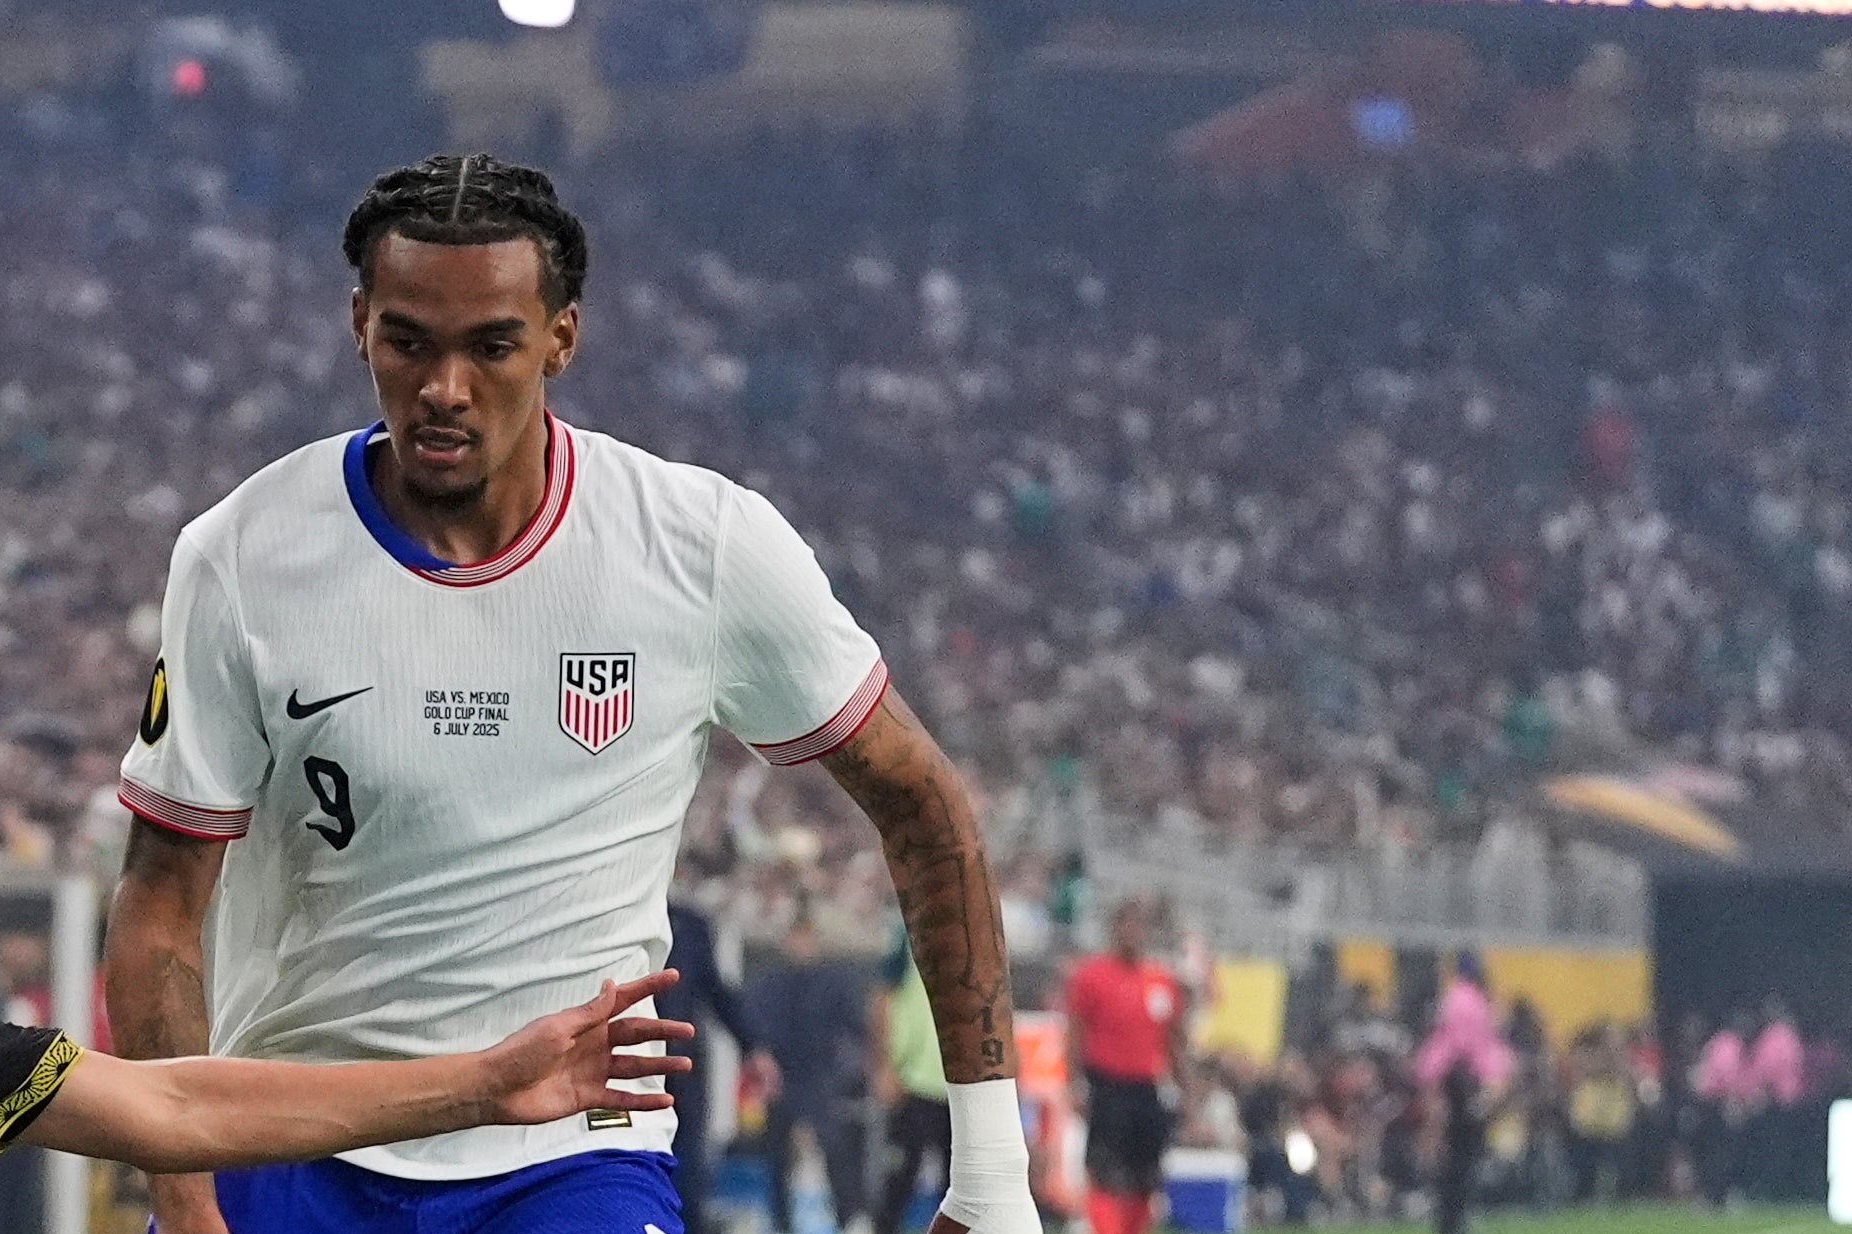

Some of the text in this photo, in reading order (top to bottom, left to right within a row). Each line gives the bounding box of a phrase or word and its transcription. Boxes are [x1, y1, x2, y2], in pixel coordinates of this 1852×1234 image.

[567, 660, 629, 696] USA
[425, 690, 510, 705] USA VS. MEXICO
[424, 706, 510, 721] GOLD CUP FINAL
[433, 722, 500, 736] 6 JULY 2025
[304, 755, 356, 852] 9
